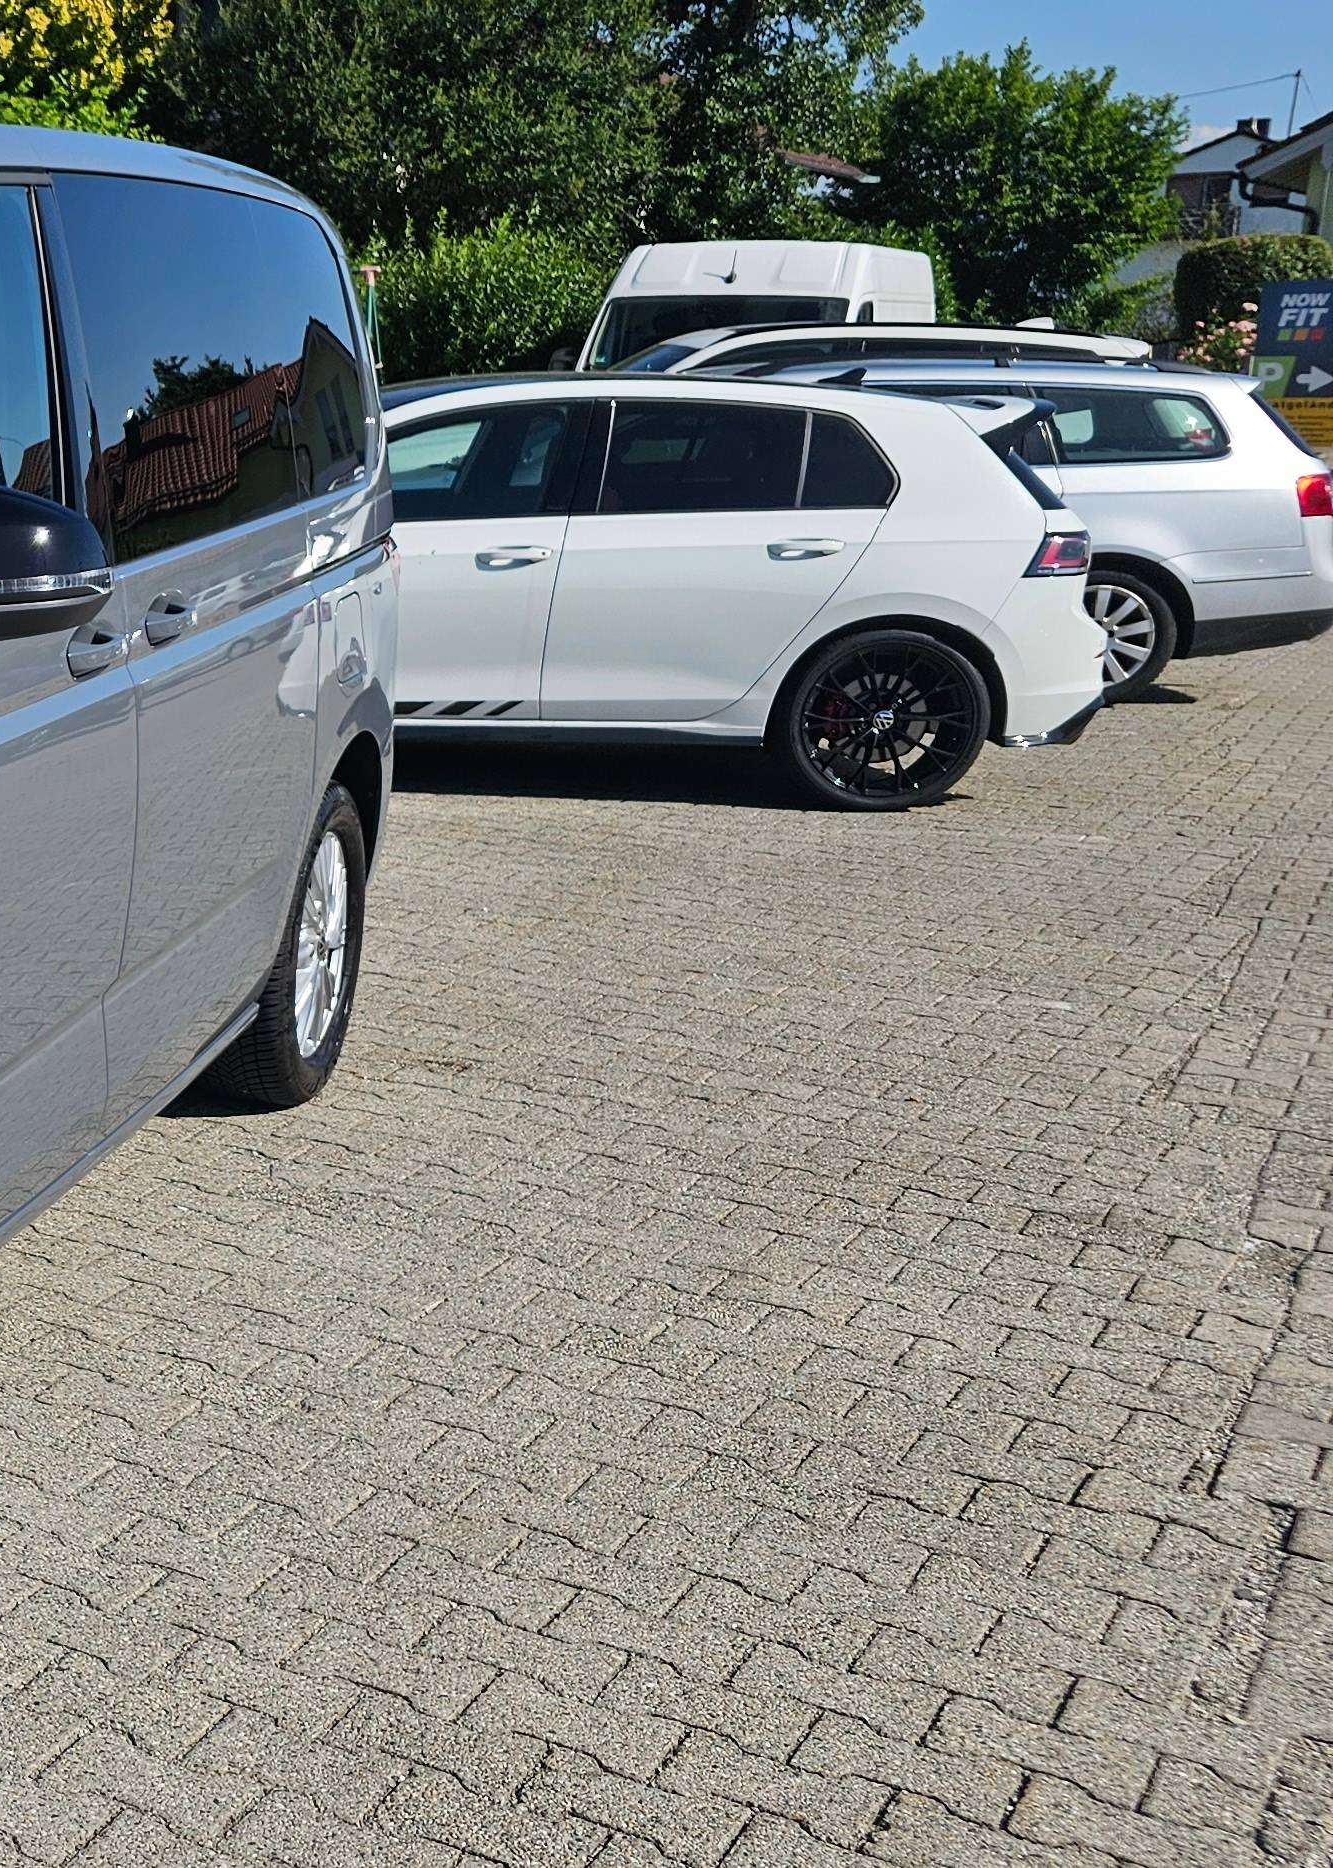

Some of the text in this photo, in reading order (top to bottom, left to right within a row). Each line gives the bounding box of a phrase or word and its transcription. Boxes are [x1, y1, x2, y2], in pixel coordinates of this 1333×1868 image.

[1280, 292, 1332, 308] NOW
[1277, 307, 1330, 327] FIT
[1257, 362, 1285, 391] P
